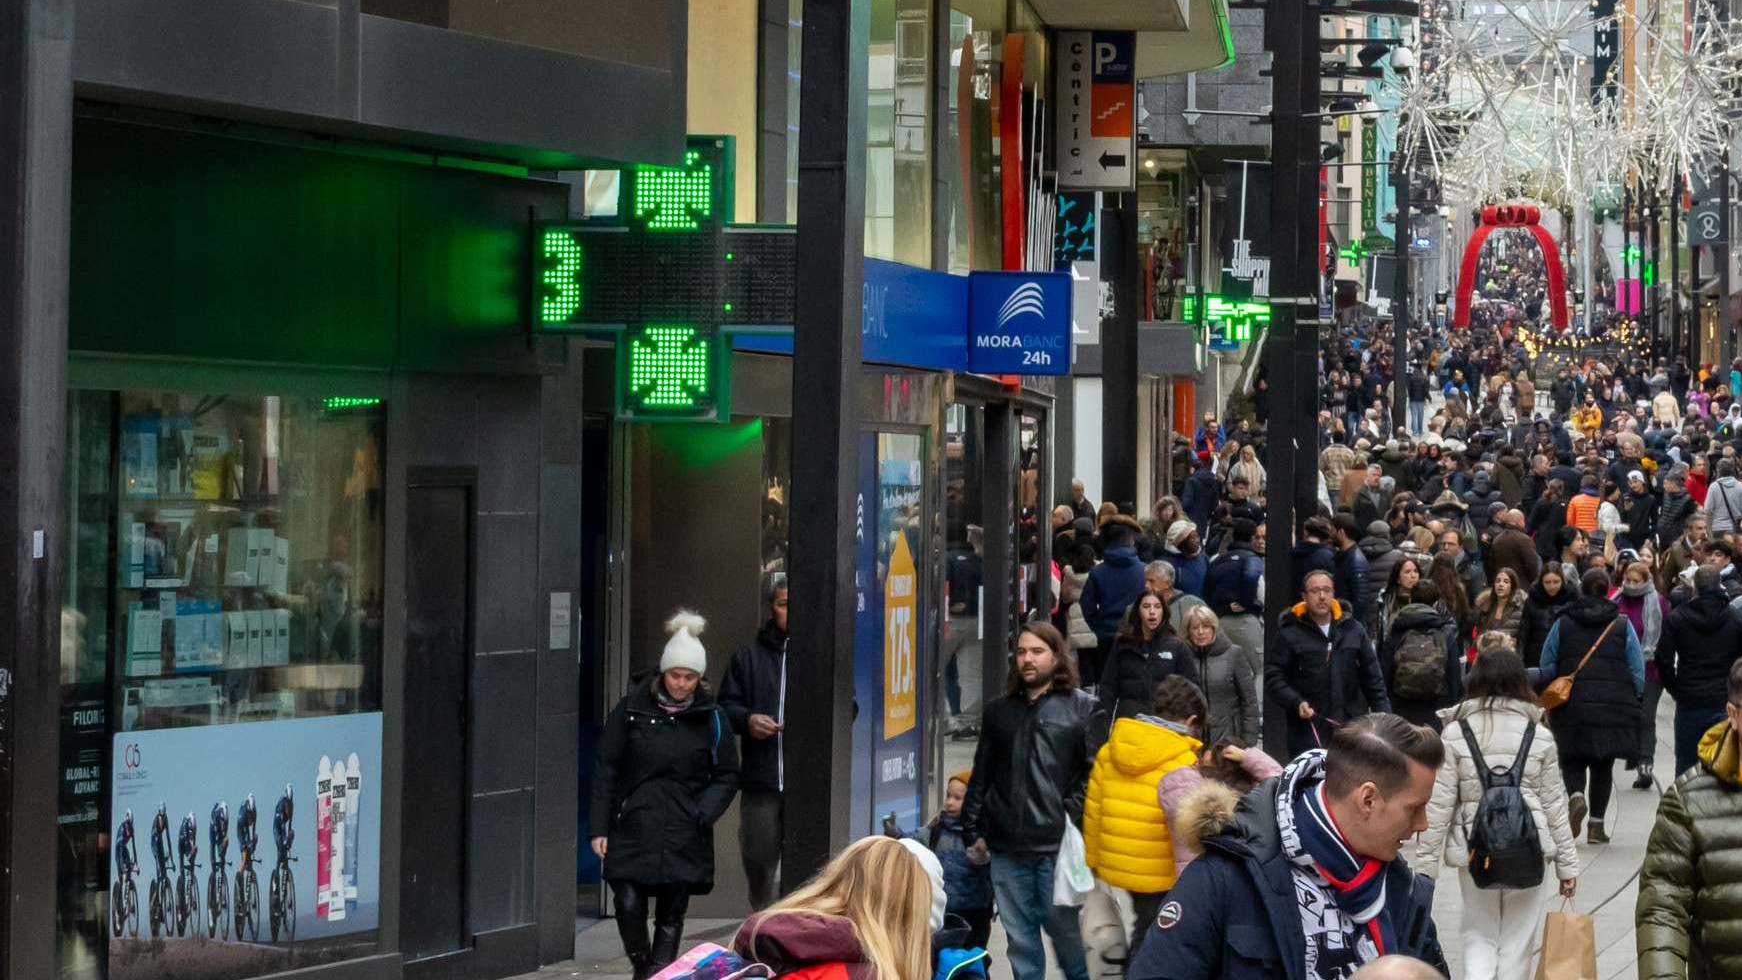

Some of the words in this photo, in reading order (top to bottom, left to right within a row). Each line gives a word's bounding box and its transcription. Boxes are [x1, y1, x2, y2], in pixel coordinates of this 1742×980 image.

[1096, 42, 1117, 75] P
[1070, 42, 1083, 157] Cèntric
[543, 233, 581, 320] 3
[977, 335, 1064, 348] MORABANC
[1022, 351, 1051, 365] 24h
